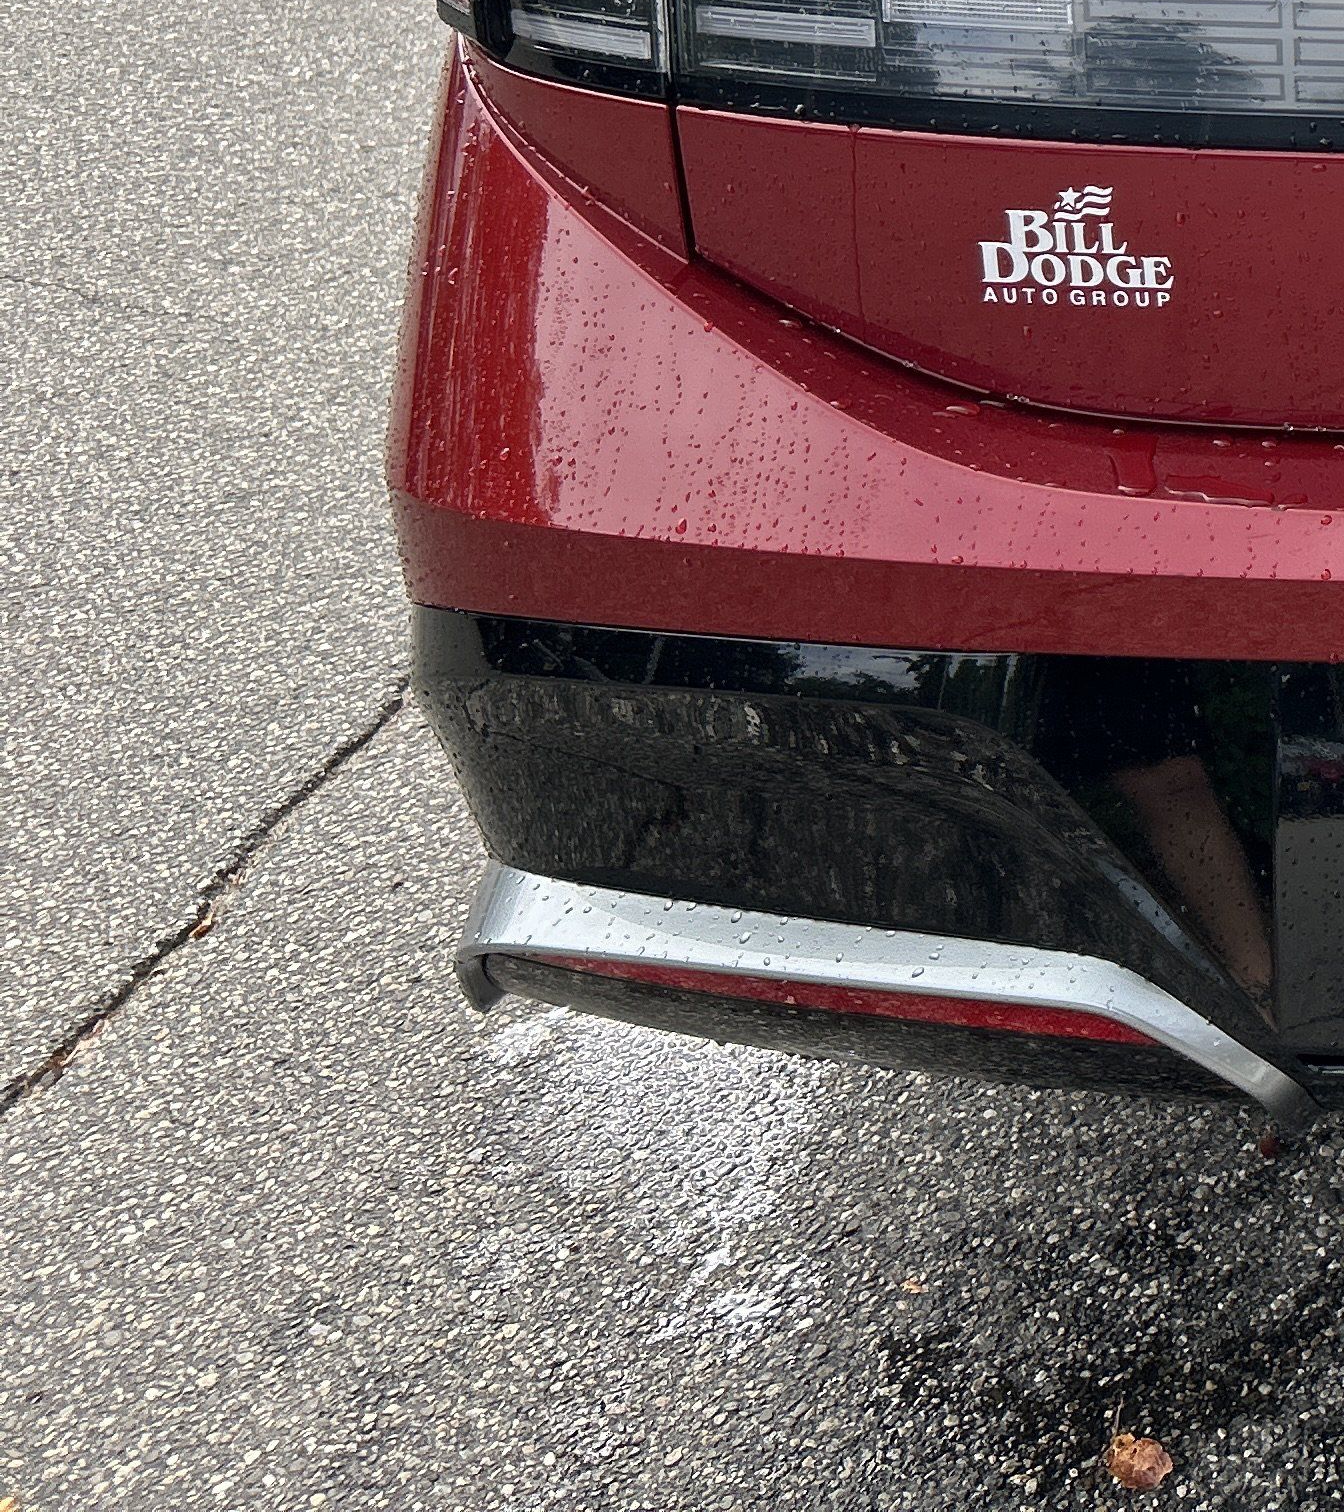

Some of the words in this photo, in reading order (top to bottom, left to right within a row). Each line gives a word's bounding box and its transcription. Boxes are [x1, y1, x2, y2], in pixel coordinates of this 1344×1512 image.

[1004, 209, 1128, 255] BILL
[977, 241, 1175, 289] DODGE
[983, 286, 1058, 305] AUTO
[1069, 289, 1171, 307] GROUP
